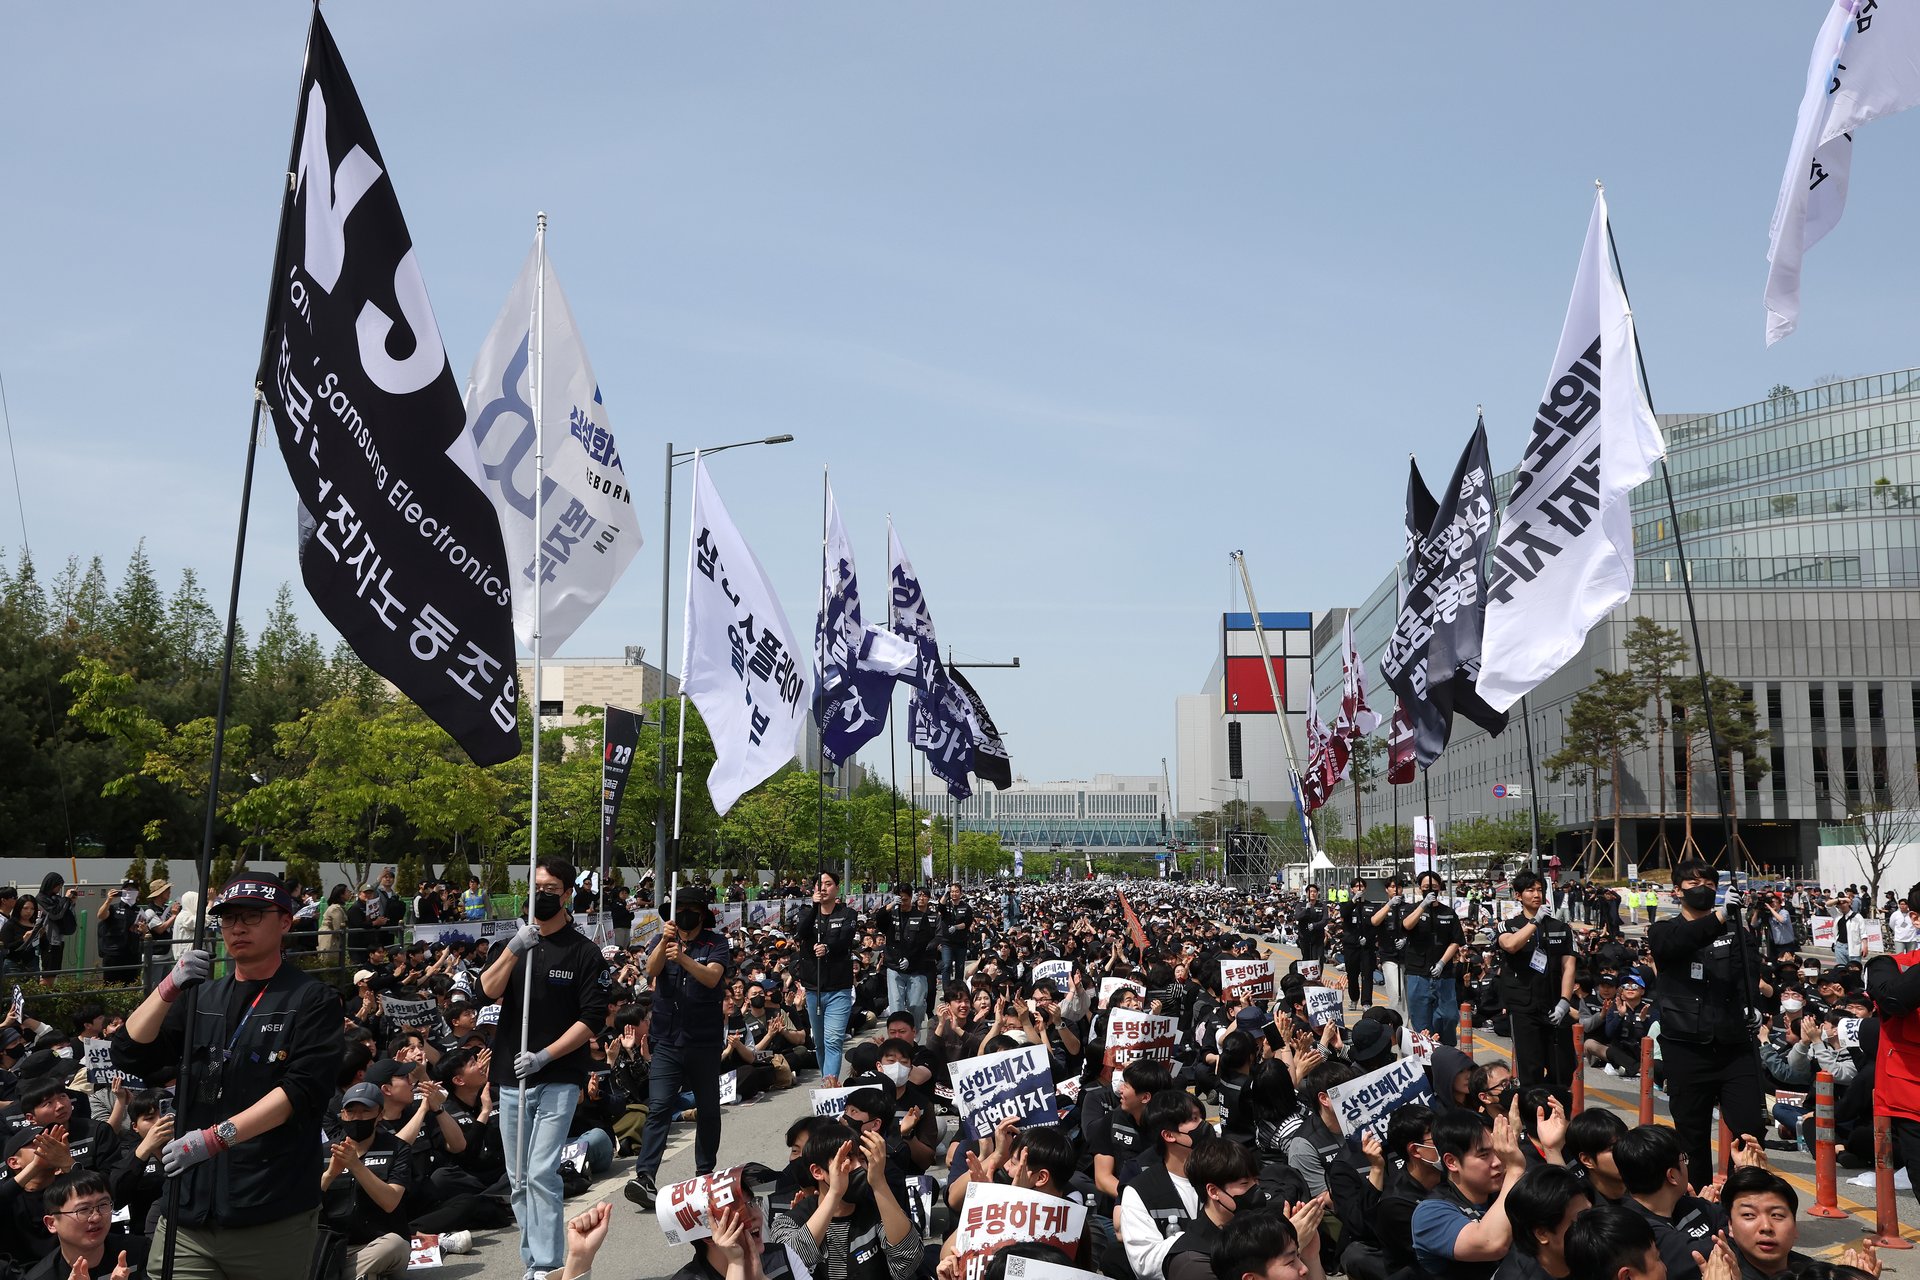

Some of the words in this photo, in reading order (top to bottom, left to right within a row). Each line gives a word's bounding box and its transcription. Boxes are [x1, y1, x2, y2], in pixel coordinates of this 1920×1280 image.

[316, 372, 389, 491] Samsung
[387, 478, 512, 607] Electronics
[549, 969, 574, 980] SGUU
[1225, 962, 1269, 981] 투명하게
[1112, 1018, 1171, 1039] 투명하게
[959, 1050, 1036, 1102] 상한폐지
[1341, 1061, 1414, 1121] 상한폐지
[1114, 1131, 1134, 1146] 투쟁
[364, 1157, 387, 1167] SELU
[965, 1200, 1071, 1238] 투명하게
[1689, 1223, 1710, 1239] SELU
[857, 1246, 879, 1265] SELU
